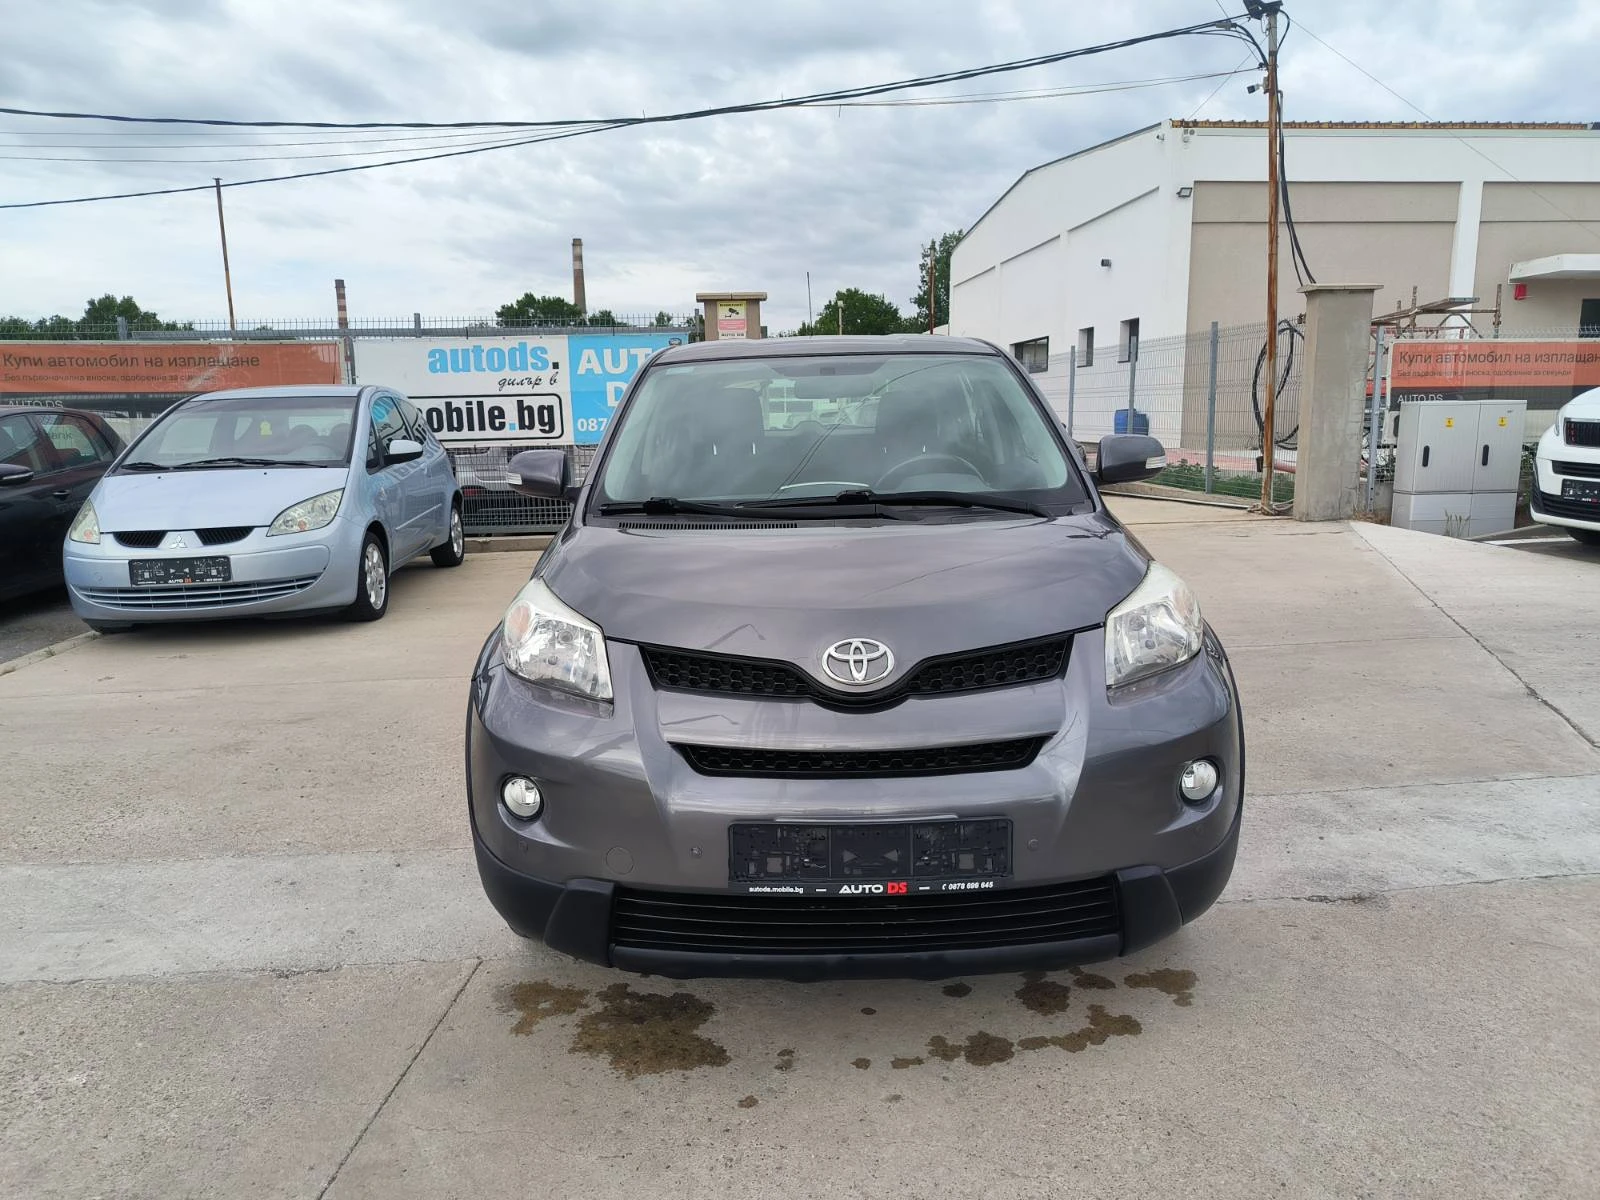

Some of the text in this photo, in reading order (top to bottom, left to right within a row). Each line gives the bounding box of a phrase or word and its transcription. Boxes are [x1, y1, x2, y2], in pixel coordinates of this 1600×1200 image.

[2, 353, 260, 370] Купи автомобил на изплащане
[577, 347, 653, 375] AUT
[1399, 351, 1600, 367] Купи автомобил на изплащан
[606, 381, 629, 407] D
[417, 399, 557, 436] obile.bg
[577, 417, 609, 432] 087
[838, 884, 884, 894] AUTO
[887, 882, 907, 894] DS
